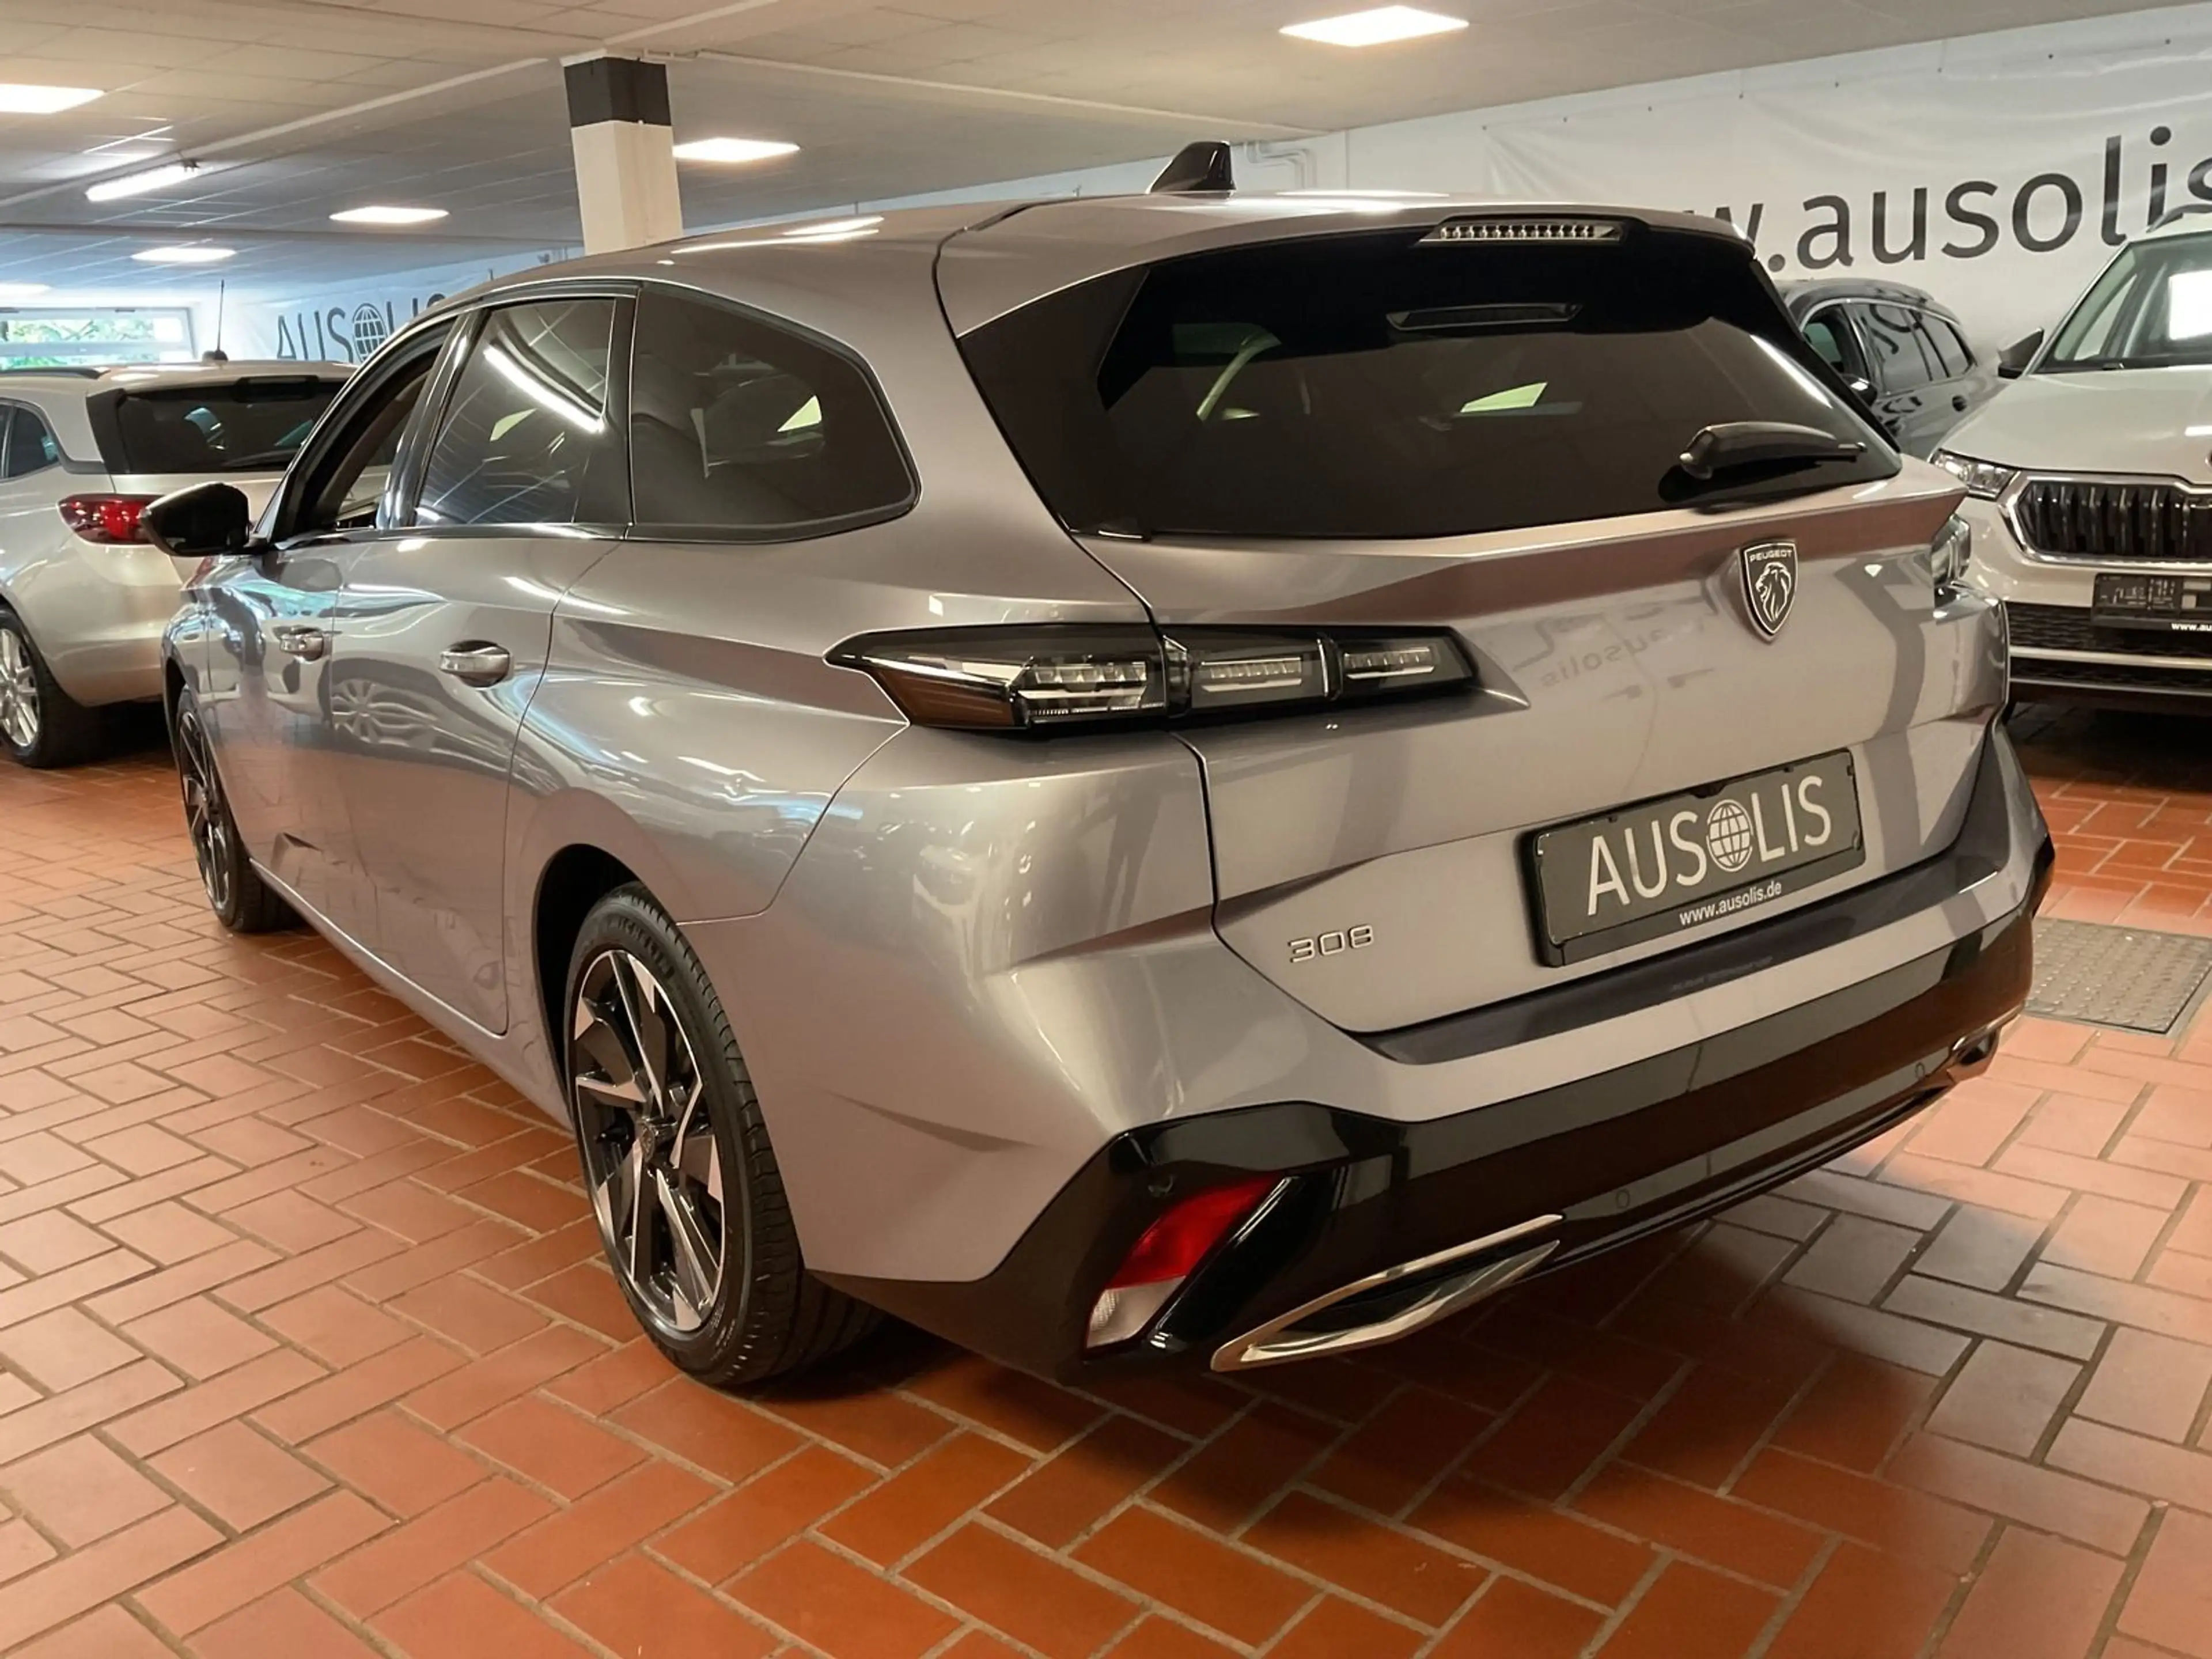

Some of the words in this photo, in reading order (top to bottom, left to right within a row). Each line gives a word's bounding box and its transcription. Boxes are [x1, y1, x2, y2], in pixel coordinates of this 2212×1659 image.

[1749, 549, 1792, 562] PEUGEOT
[1588, 775, 1831, 915] AUSOLIS
[1679, 881, 1782, 925] www.ausolis.de
[1288, 925, 1373, 963] 308
